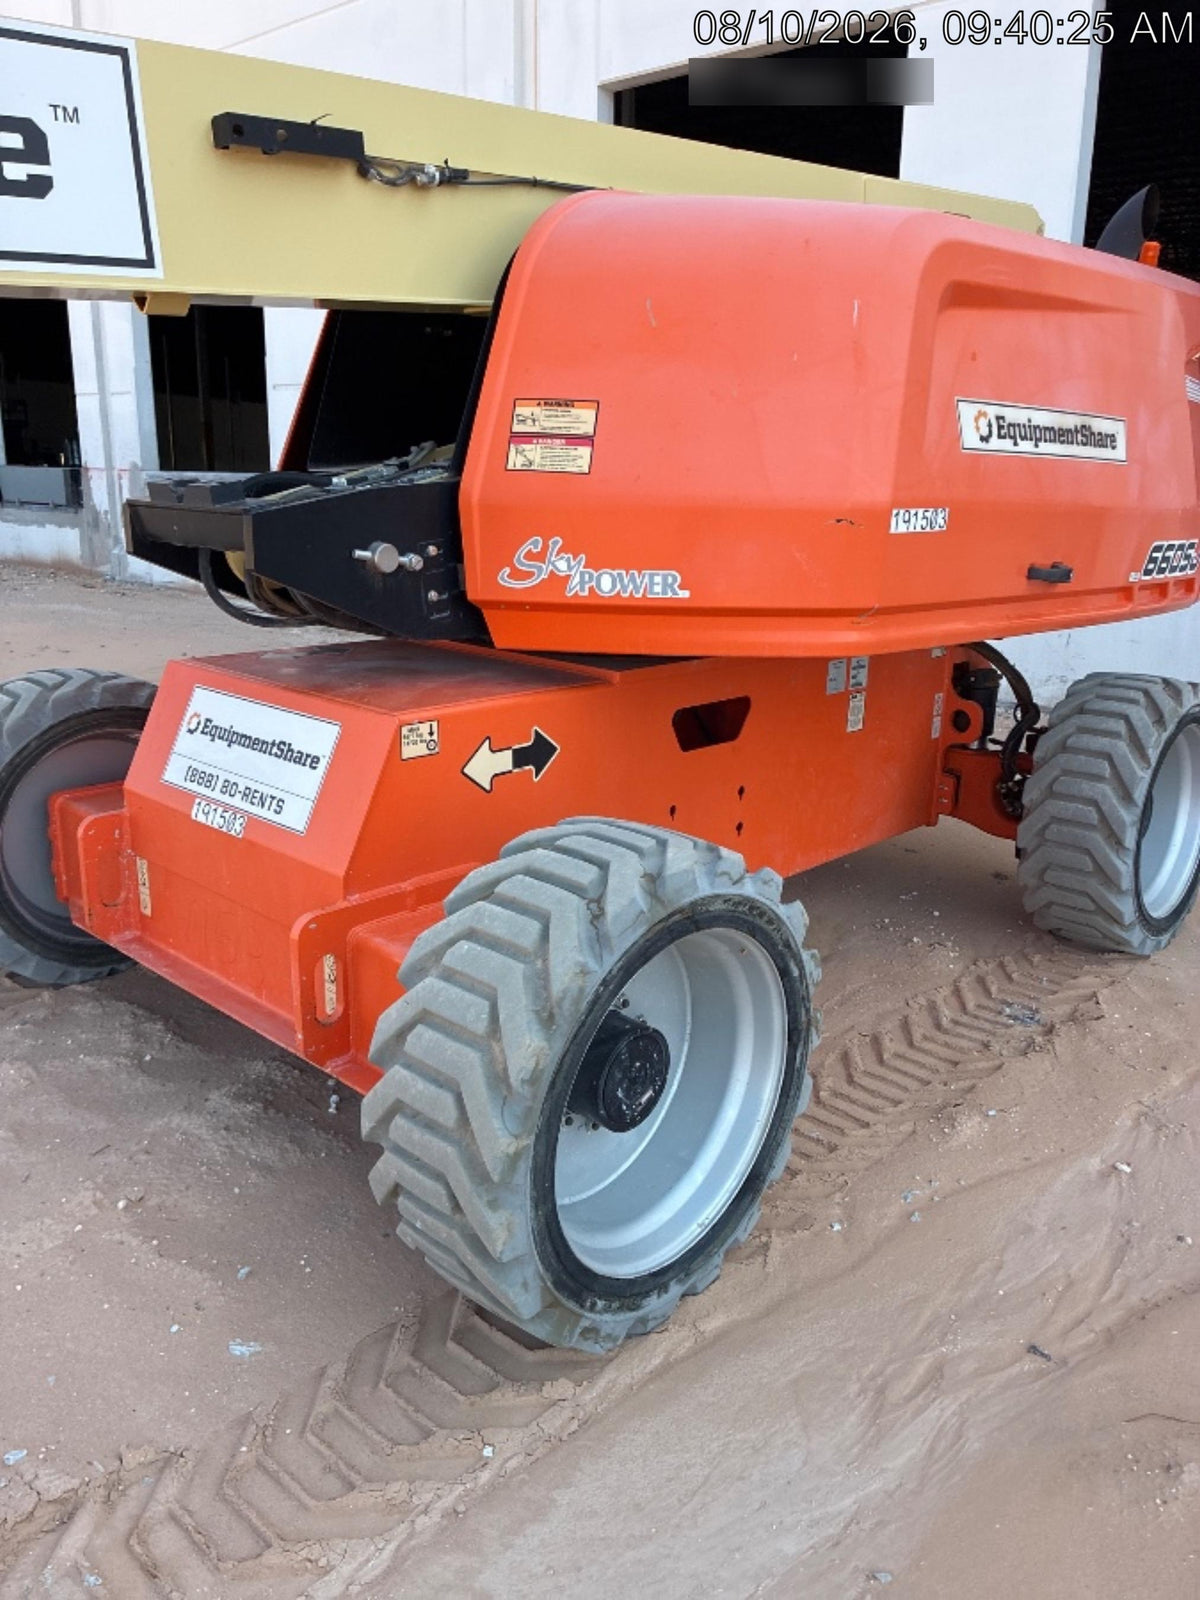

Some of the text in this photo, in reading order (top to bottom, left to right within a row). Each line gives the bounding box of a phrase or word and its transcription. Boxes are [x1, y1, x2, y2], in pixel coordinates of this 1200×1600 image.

[995, 415, 1118, 450] EquipmentShare
[894, 508, 947, 531] 191503
[200, 717, 321, 771] EquipmentShare
[184, 765, 220, 792] (888)
[194, 801, 247, 837] 191503
